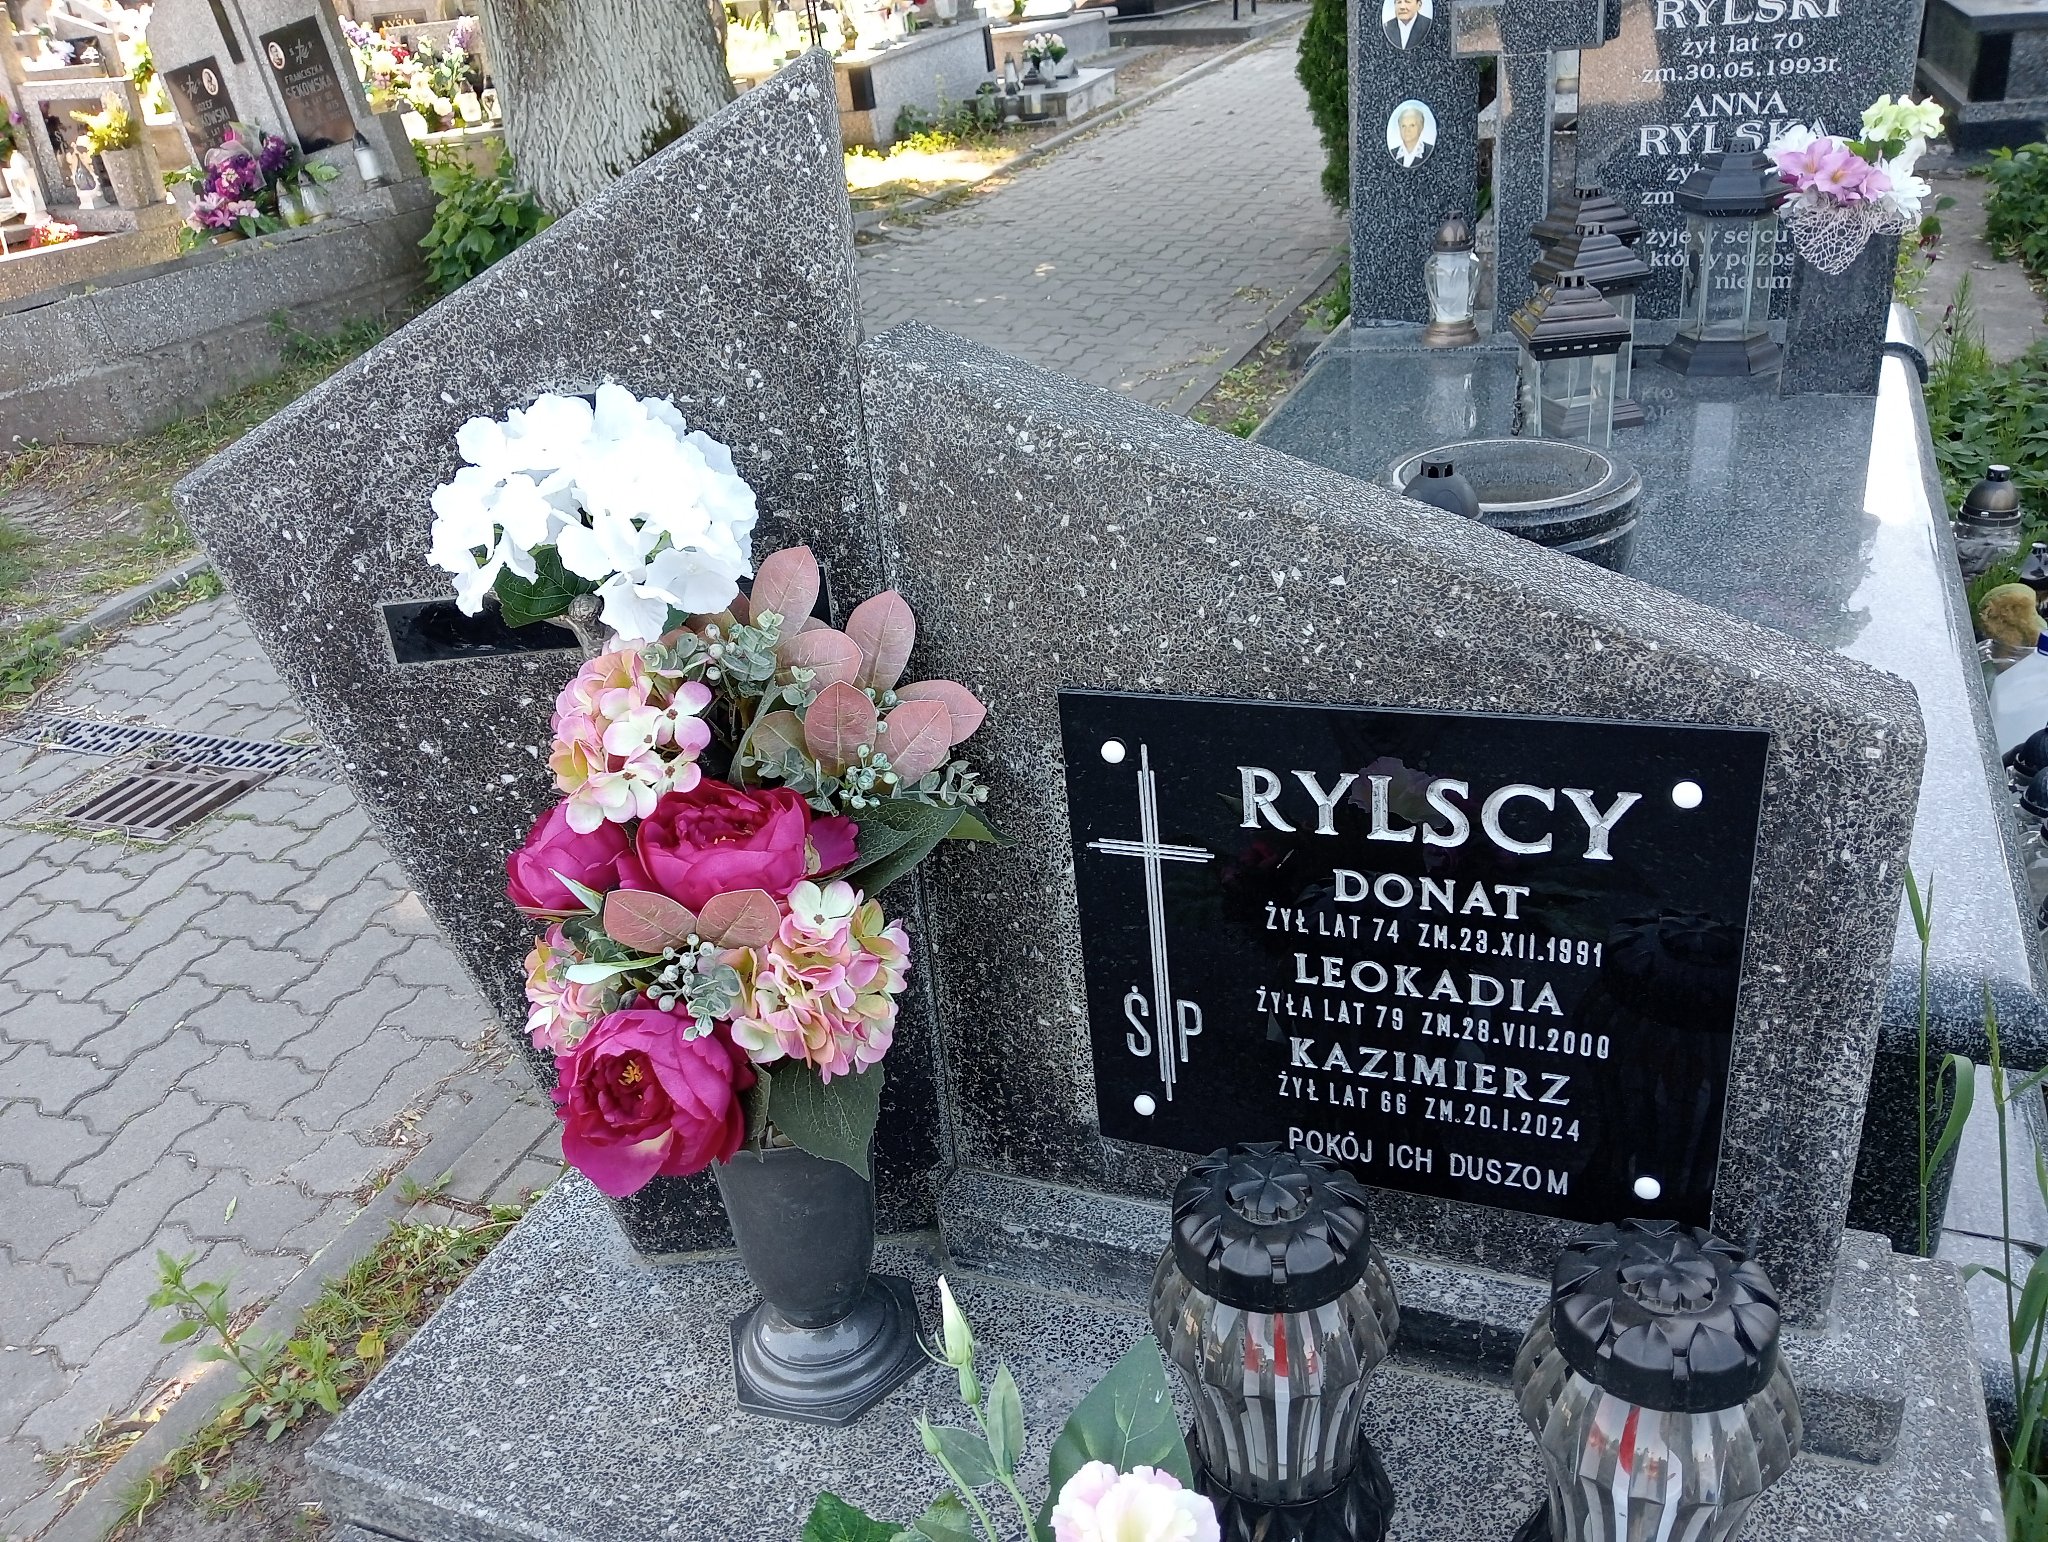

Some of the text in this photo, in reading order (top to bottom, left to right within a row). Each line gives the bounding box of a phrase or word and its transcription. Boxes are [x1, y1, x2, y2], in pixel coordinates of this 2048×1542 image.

[1655, 0, 1841, 30] RYLSKI
[1682, 32, 1804, 58] żył lat 70
[1641, 57, 1843, 83] zm.30.05.1993r.
[1683, 90, 1788, 118] ANNA
[1645, 228, 1692, 248] żyje
[1236, 765, 1643, 861] RYLSCY
[1332, 868, 1531, 920] DONAT
[1265, 900, 1603, 968] ŻYŁ LAT 74 ZM.23.XII.1991
[1293, 952, 1564, 1016] LEOKADIA
[1256, 985, 1611, 1060] ŻYŁA LAT 79 ZM.28.VII.2000
[1289, 1035, 1571, 1106] KAZIMIERZ
[1278, 1069, 1581, 1143] ŻYŁ LAT 66 ZM.20.I.2024
[1288, 1126, 1569, 1196] POKÓJ ICH DUSZOM
